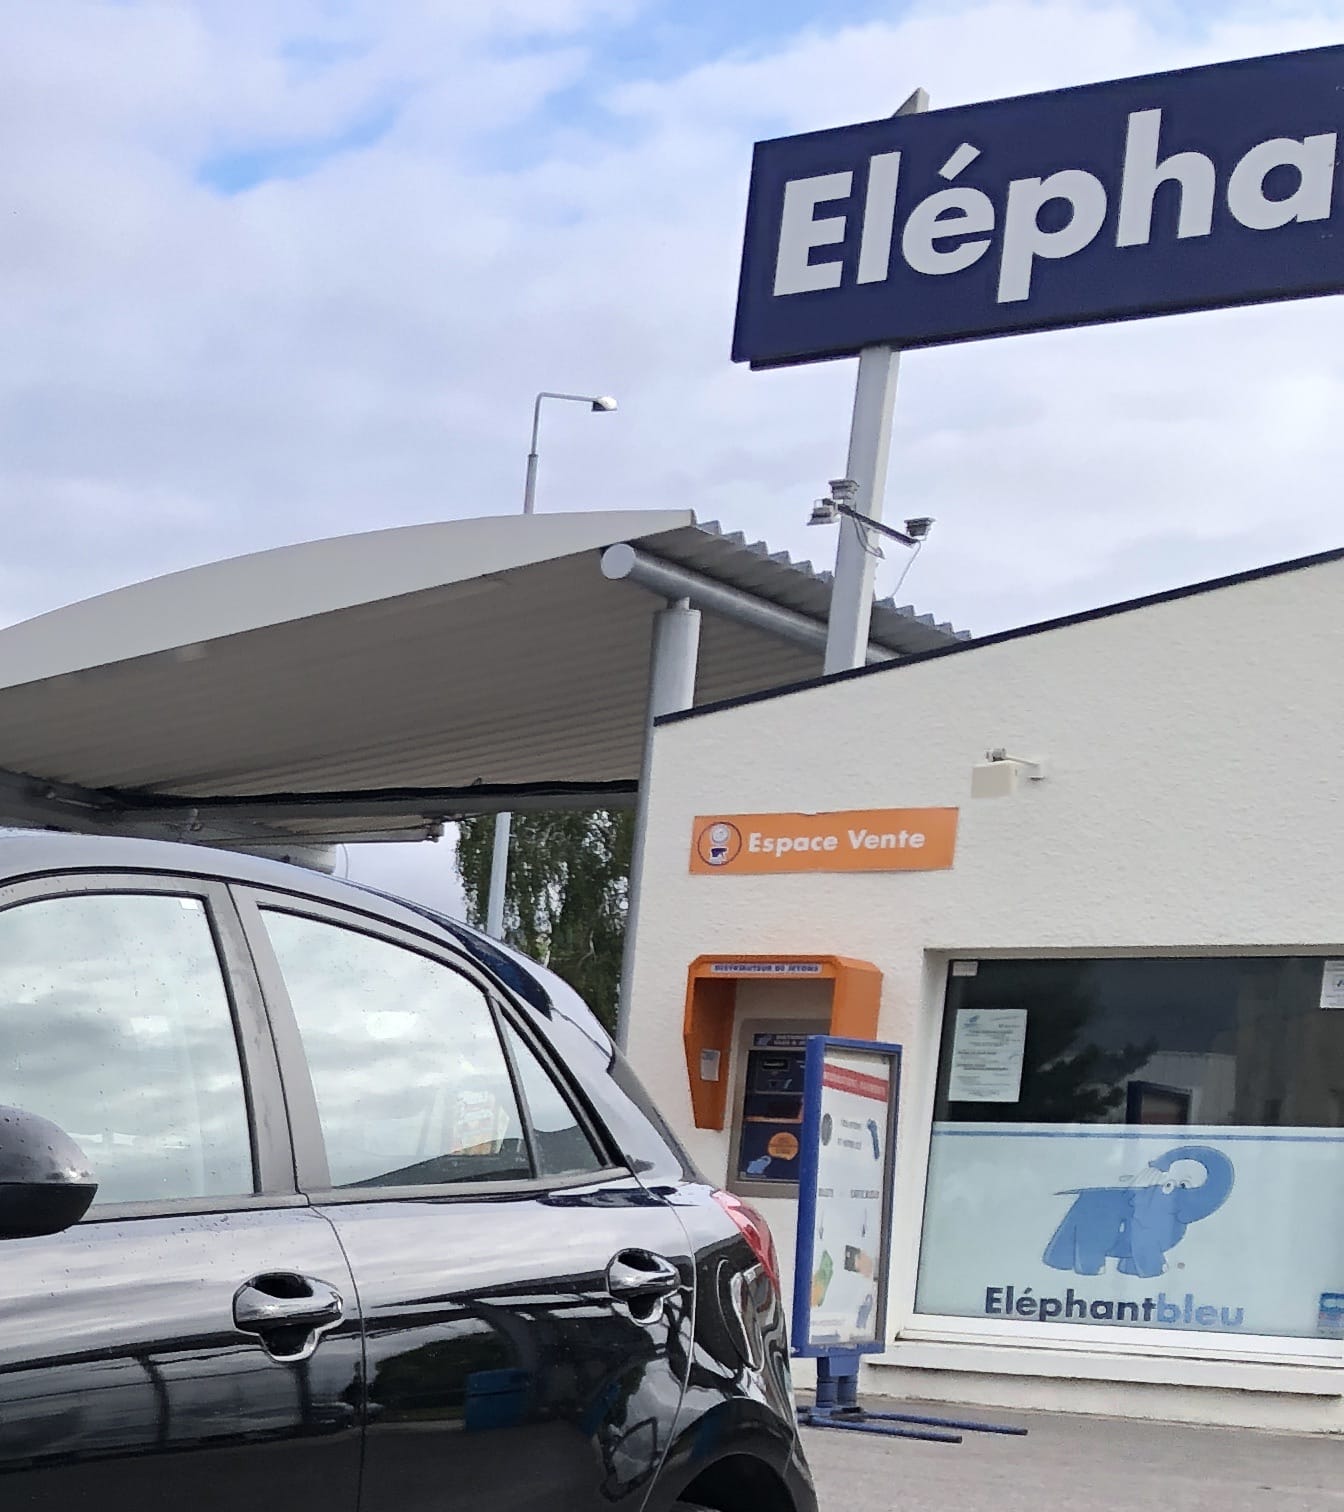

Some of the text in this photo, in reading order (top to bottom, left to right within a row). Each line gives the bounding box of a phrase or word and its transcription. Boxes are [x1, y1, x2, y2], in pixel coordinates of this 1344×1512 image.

[773, 108, 1338, 304] Elépha
[748, 829, 926, 857] Espace Vente
